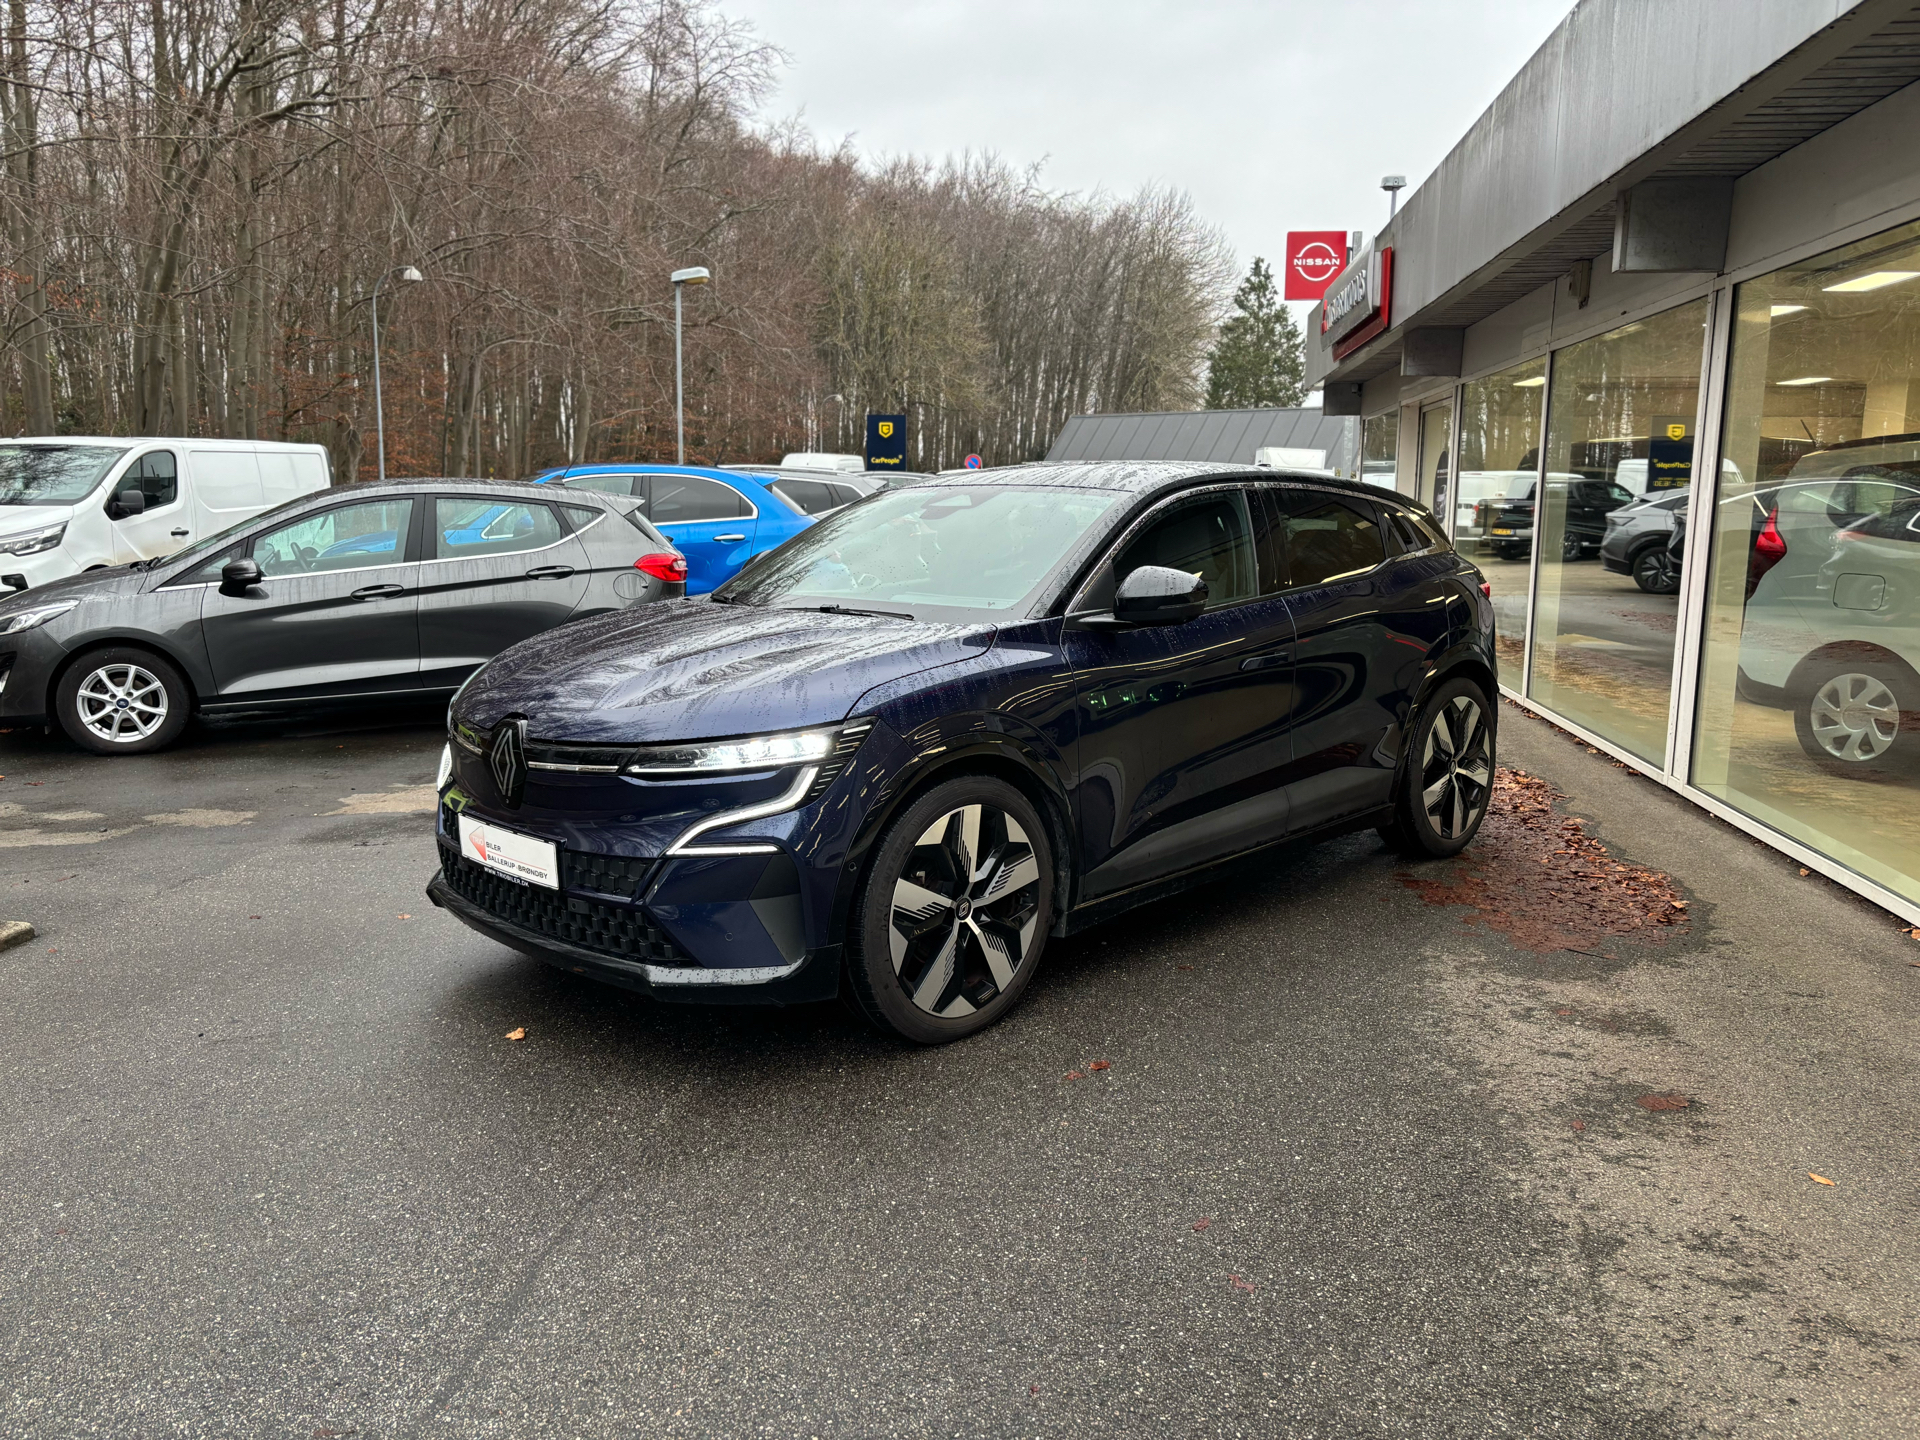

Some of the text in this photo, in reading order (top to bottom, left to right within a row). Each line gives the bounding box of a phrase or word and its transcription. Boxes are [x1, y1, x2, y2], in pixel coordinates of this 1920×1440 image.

[1293, 258, 1340, 266] NISSAN
[871, 457, 900, 465] CarPeople
[471, 835, 484, 847] TRIO
[485, 841, 501, 853] BILER
[487, 853, 548, 880] BALLERUP BRØNDBY
